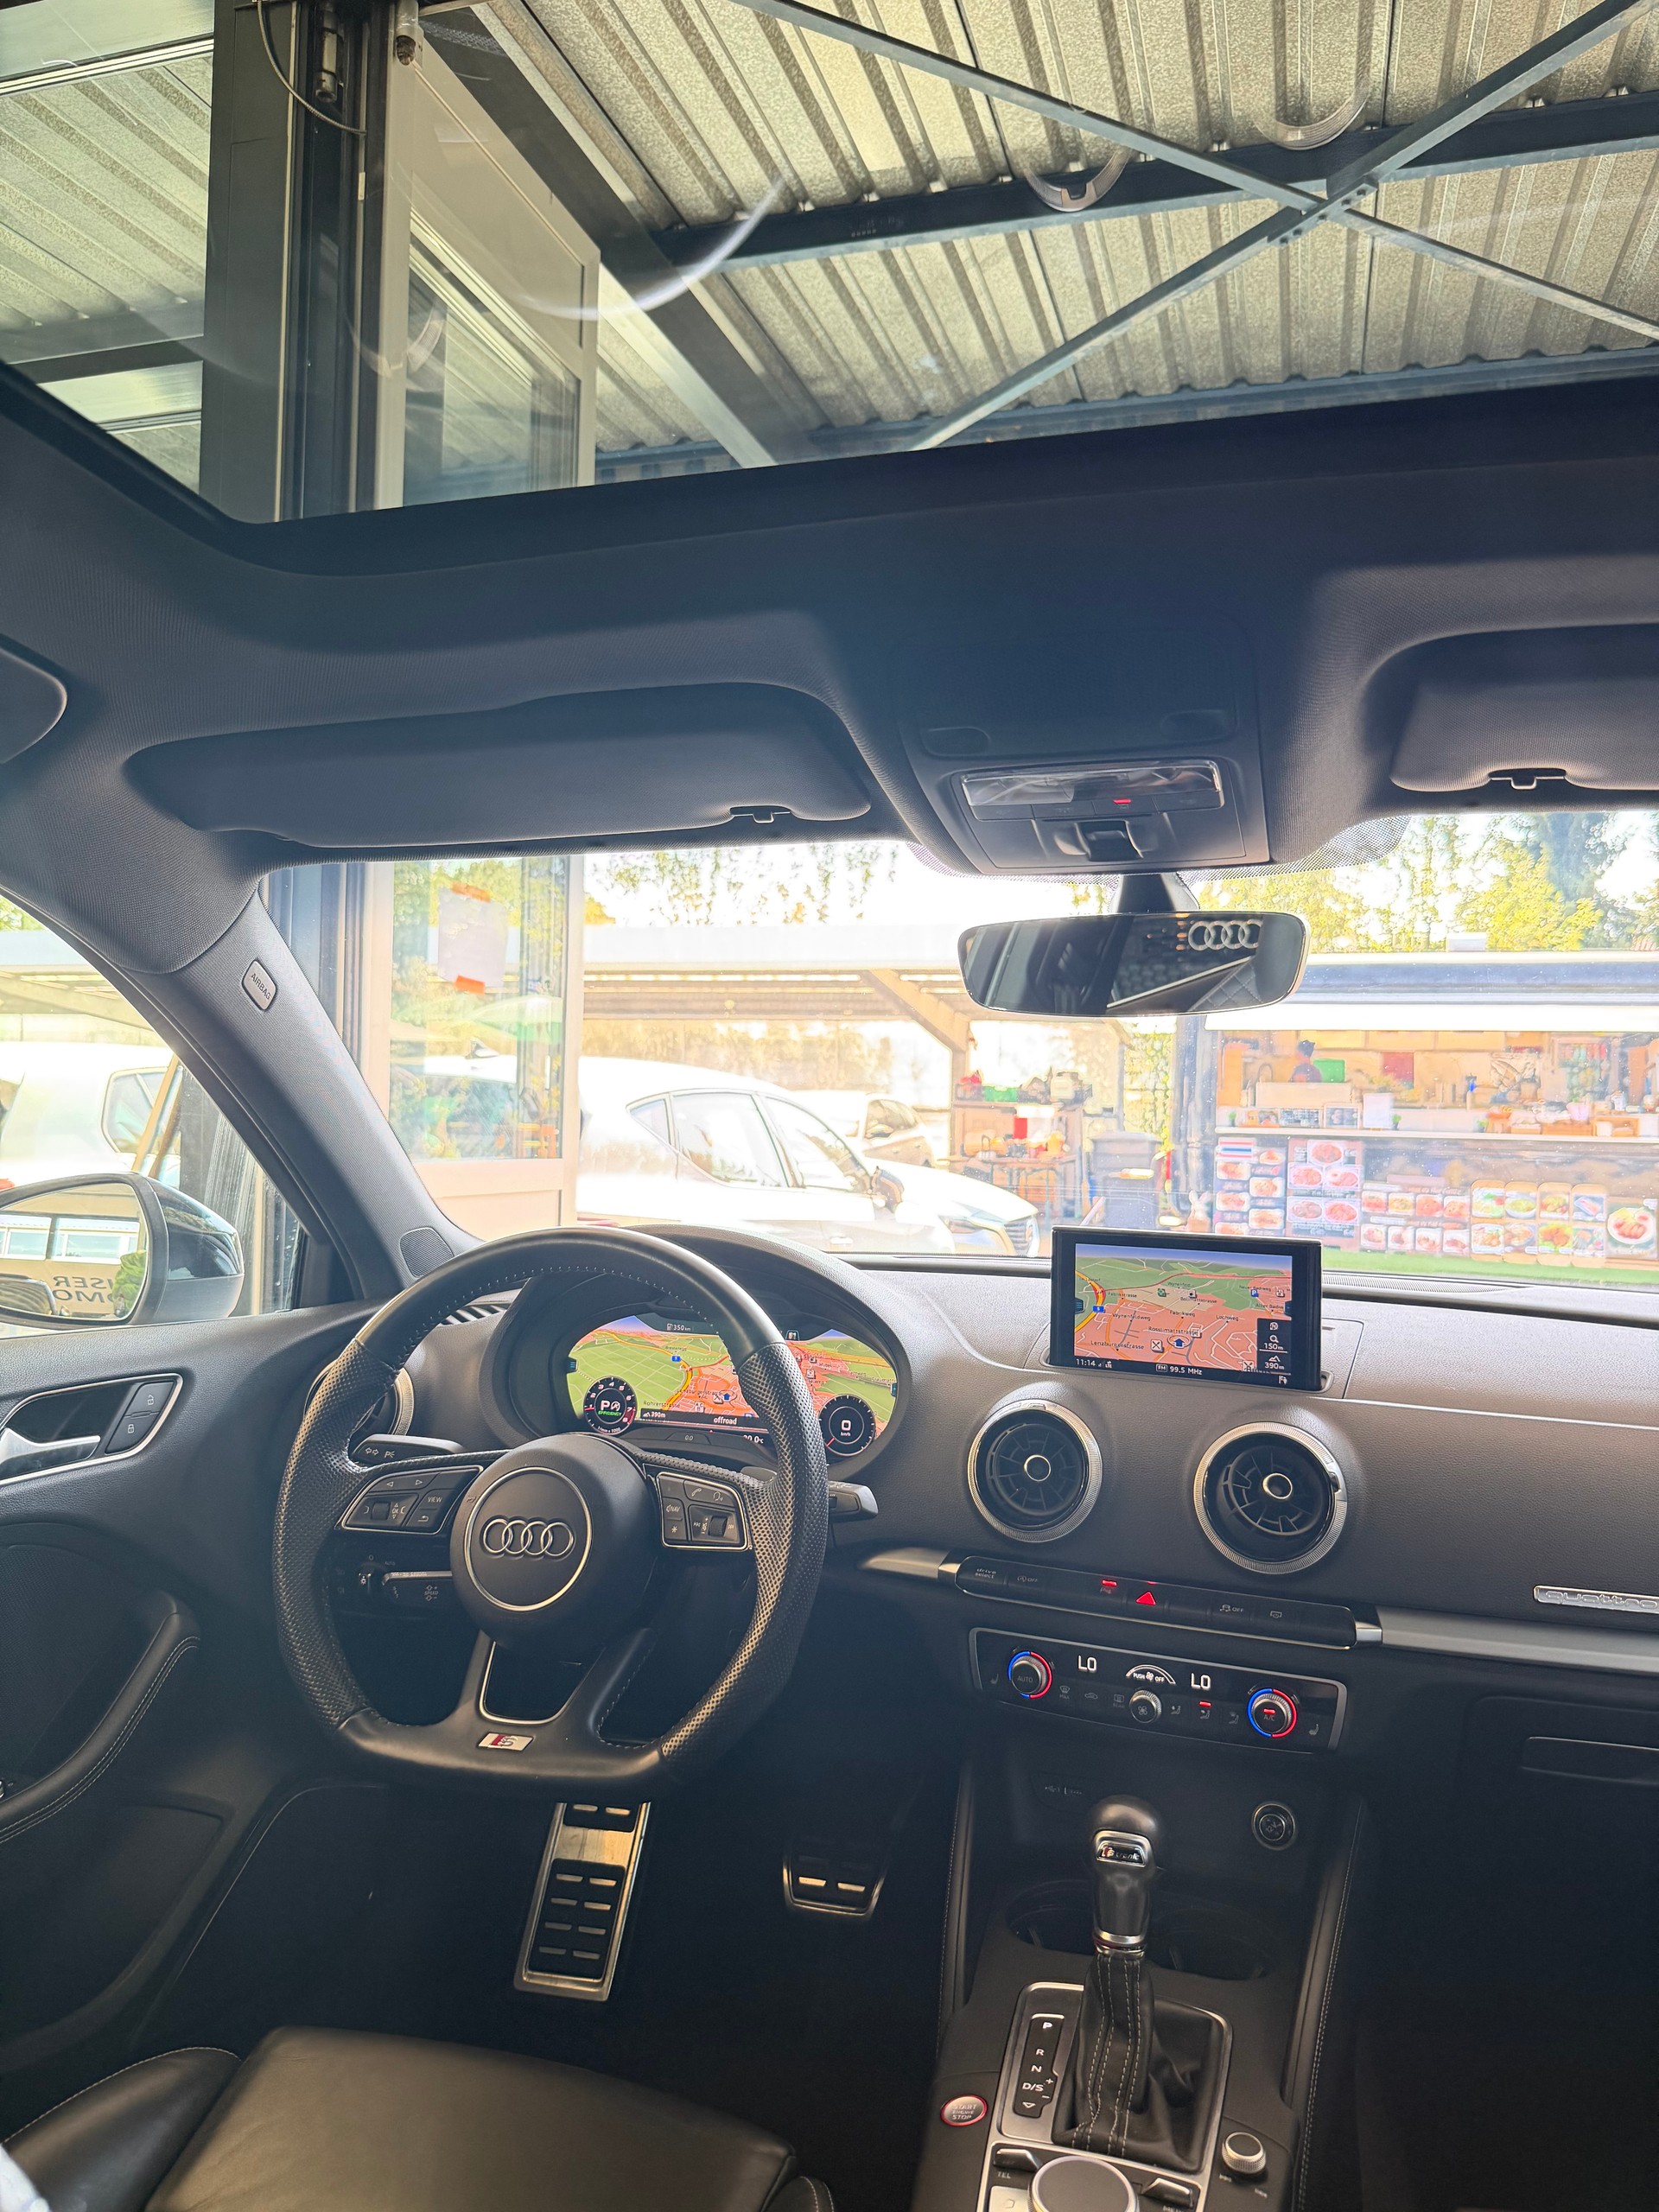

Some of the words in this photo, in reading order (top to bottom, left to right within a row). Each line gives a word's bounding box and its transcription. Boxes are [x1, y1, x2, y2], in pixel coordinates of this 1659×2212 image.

[251, 973, 271, 1001] AIRBAG
[1090, 1340, 1145, 1350] Lenzburgerstrasse
[643, 1400, 680, 1408] Rohrerstrasse
[841, 1420, 852, 1431] 0
[1545, 1590, 1658, 1609] quattro
[1077, 1655, 1097, 1672] LO
[1191, 1673, 1211, 1691] LO
[1022, 2082, 1044, 2092] D/S
